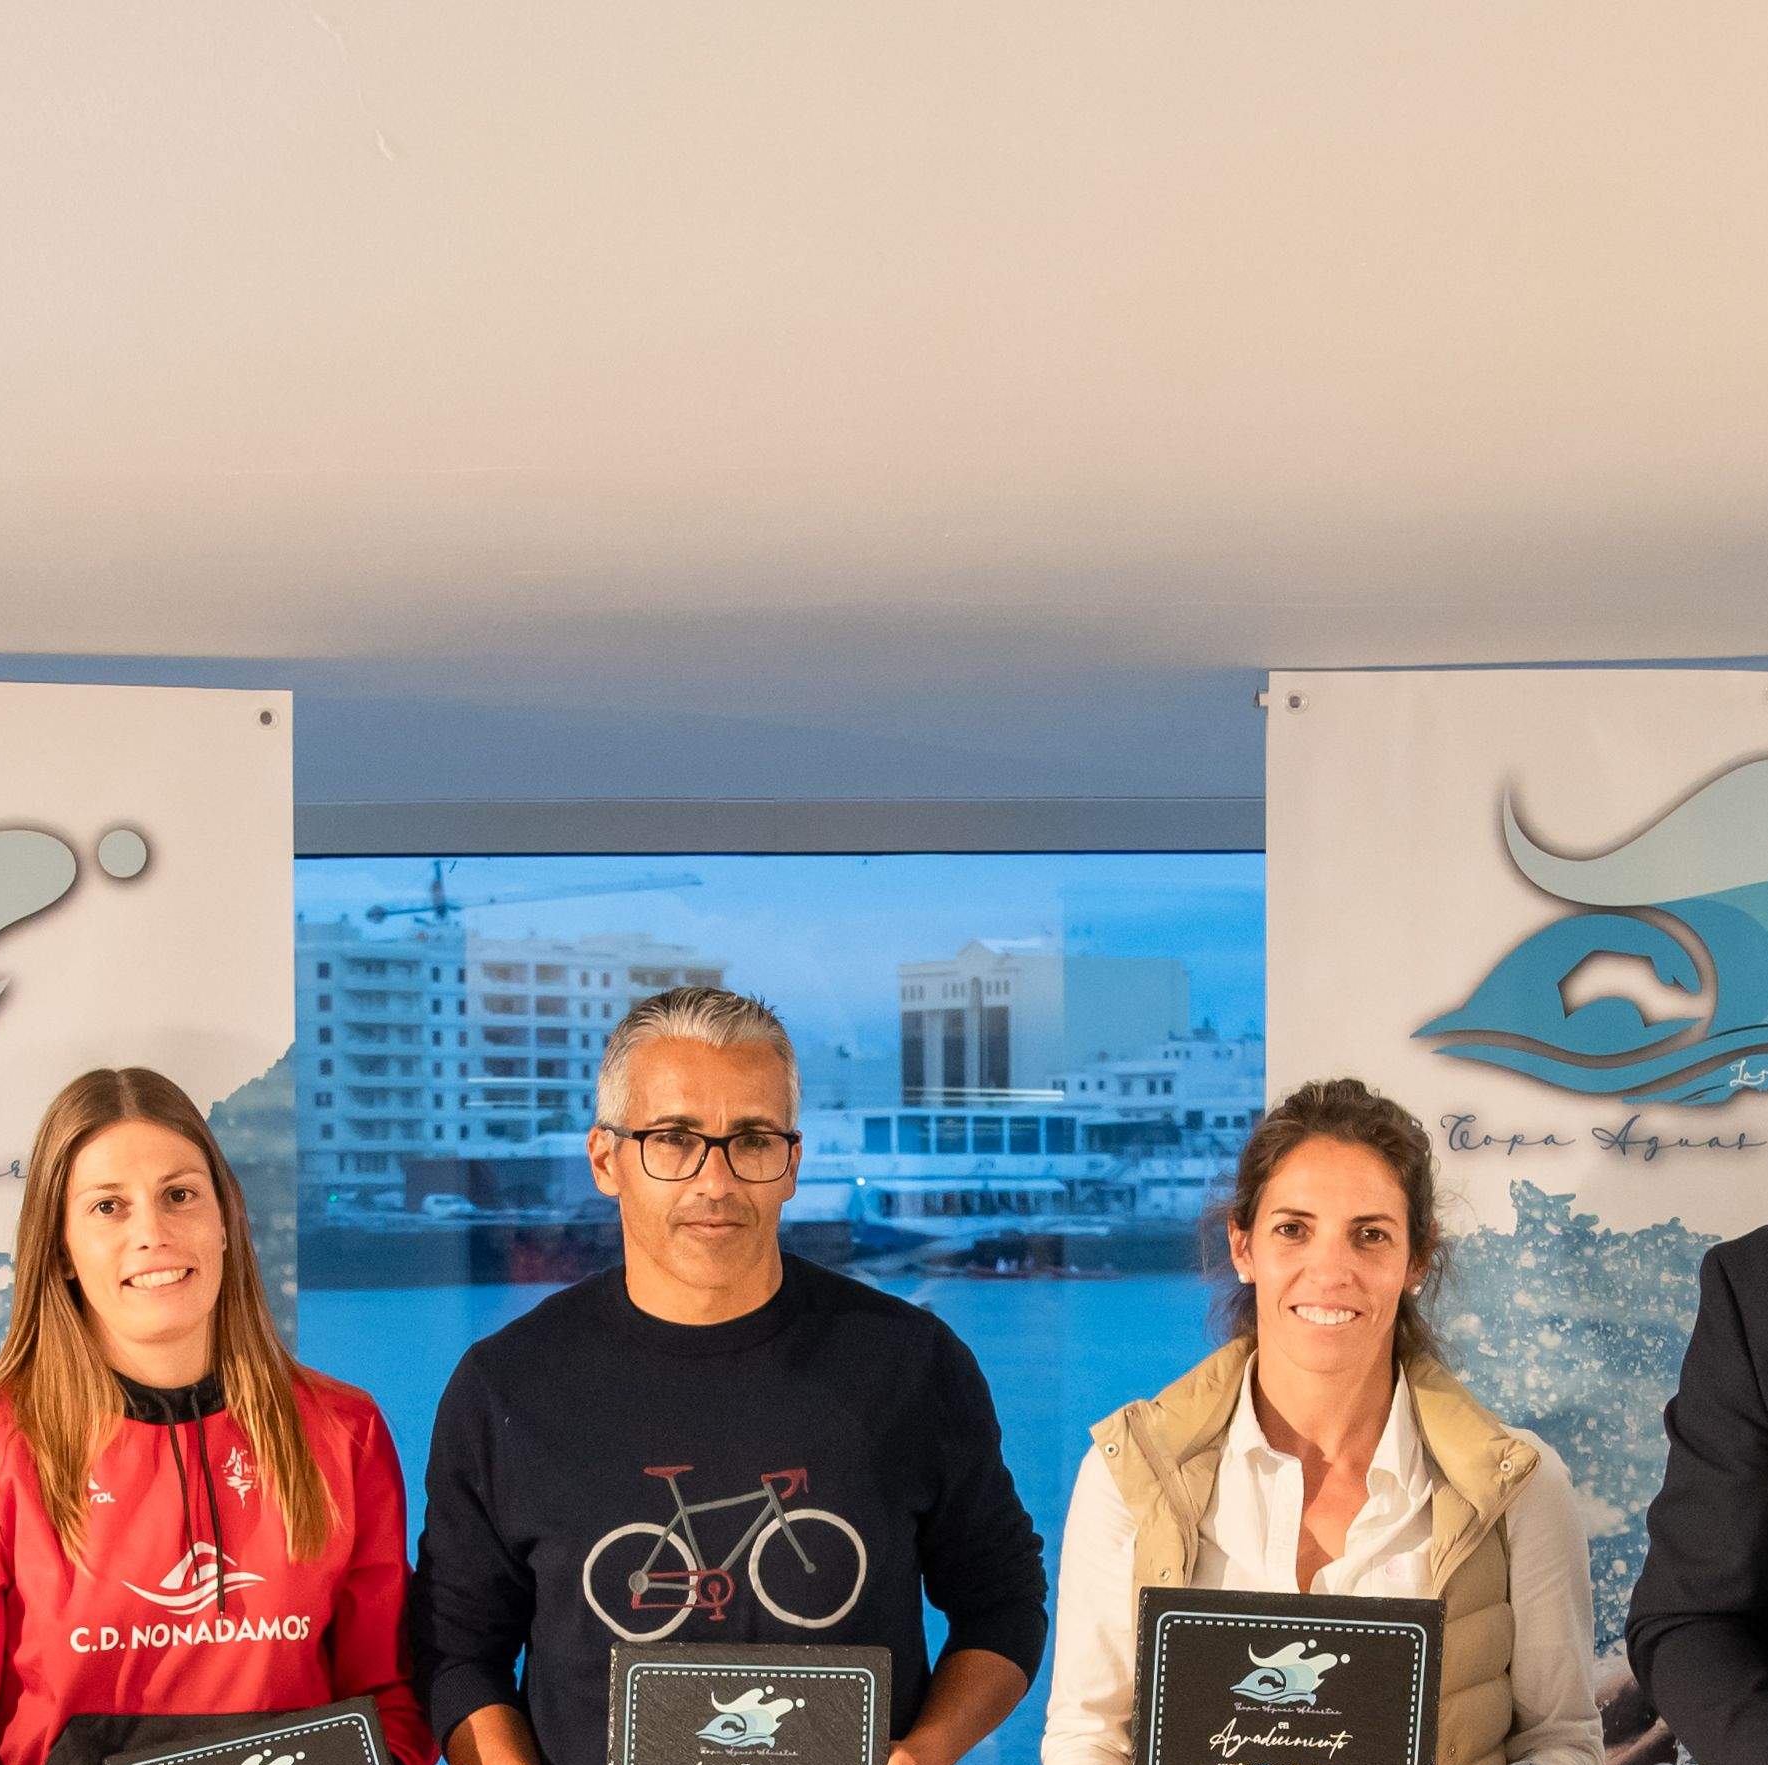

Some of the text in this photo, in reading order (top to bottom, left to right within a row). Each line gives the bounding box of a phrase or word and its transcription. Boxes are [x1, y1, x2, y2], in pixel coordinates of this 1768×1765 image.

[1440, 1114, 1576, 1156] Copa
[1592, 1114, 1768, 1160] Aguas
[70, 1615, 311, 1653] C.D. NONADAMOS
[1278, 1721, 1289, 1730] en
